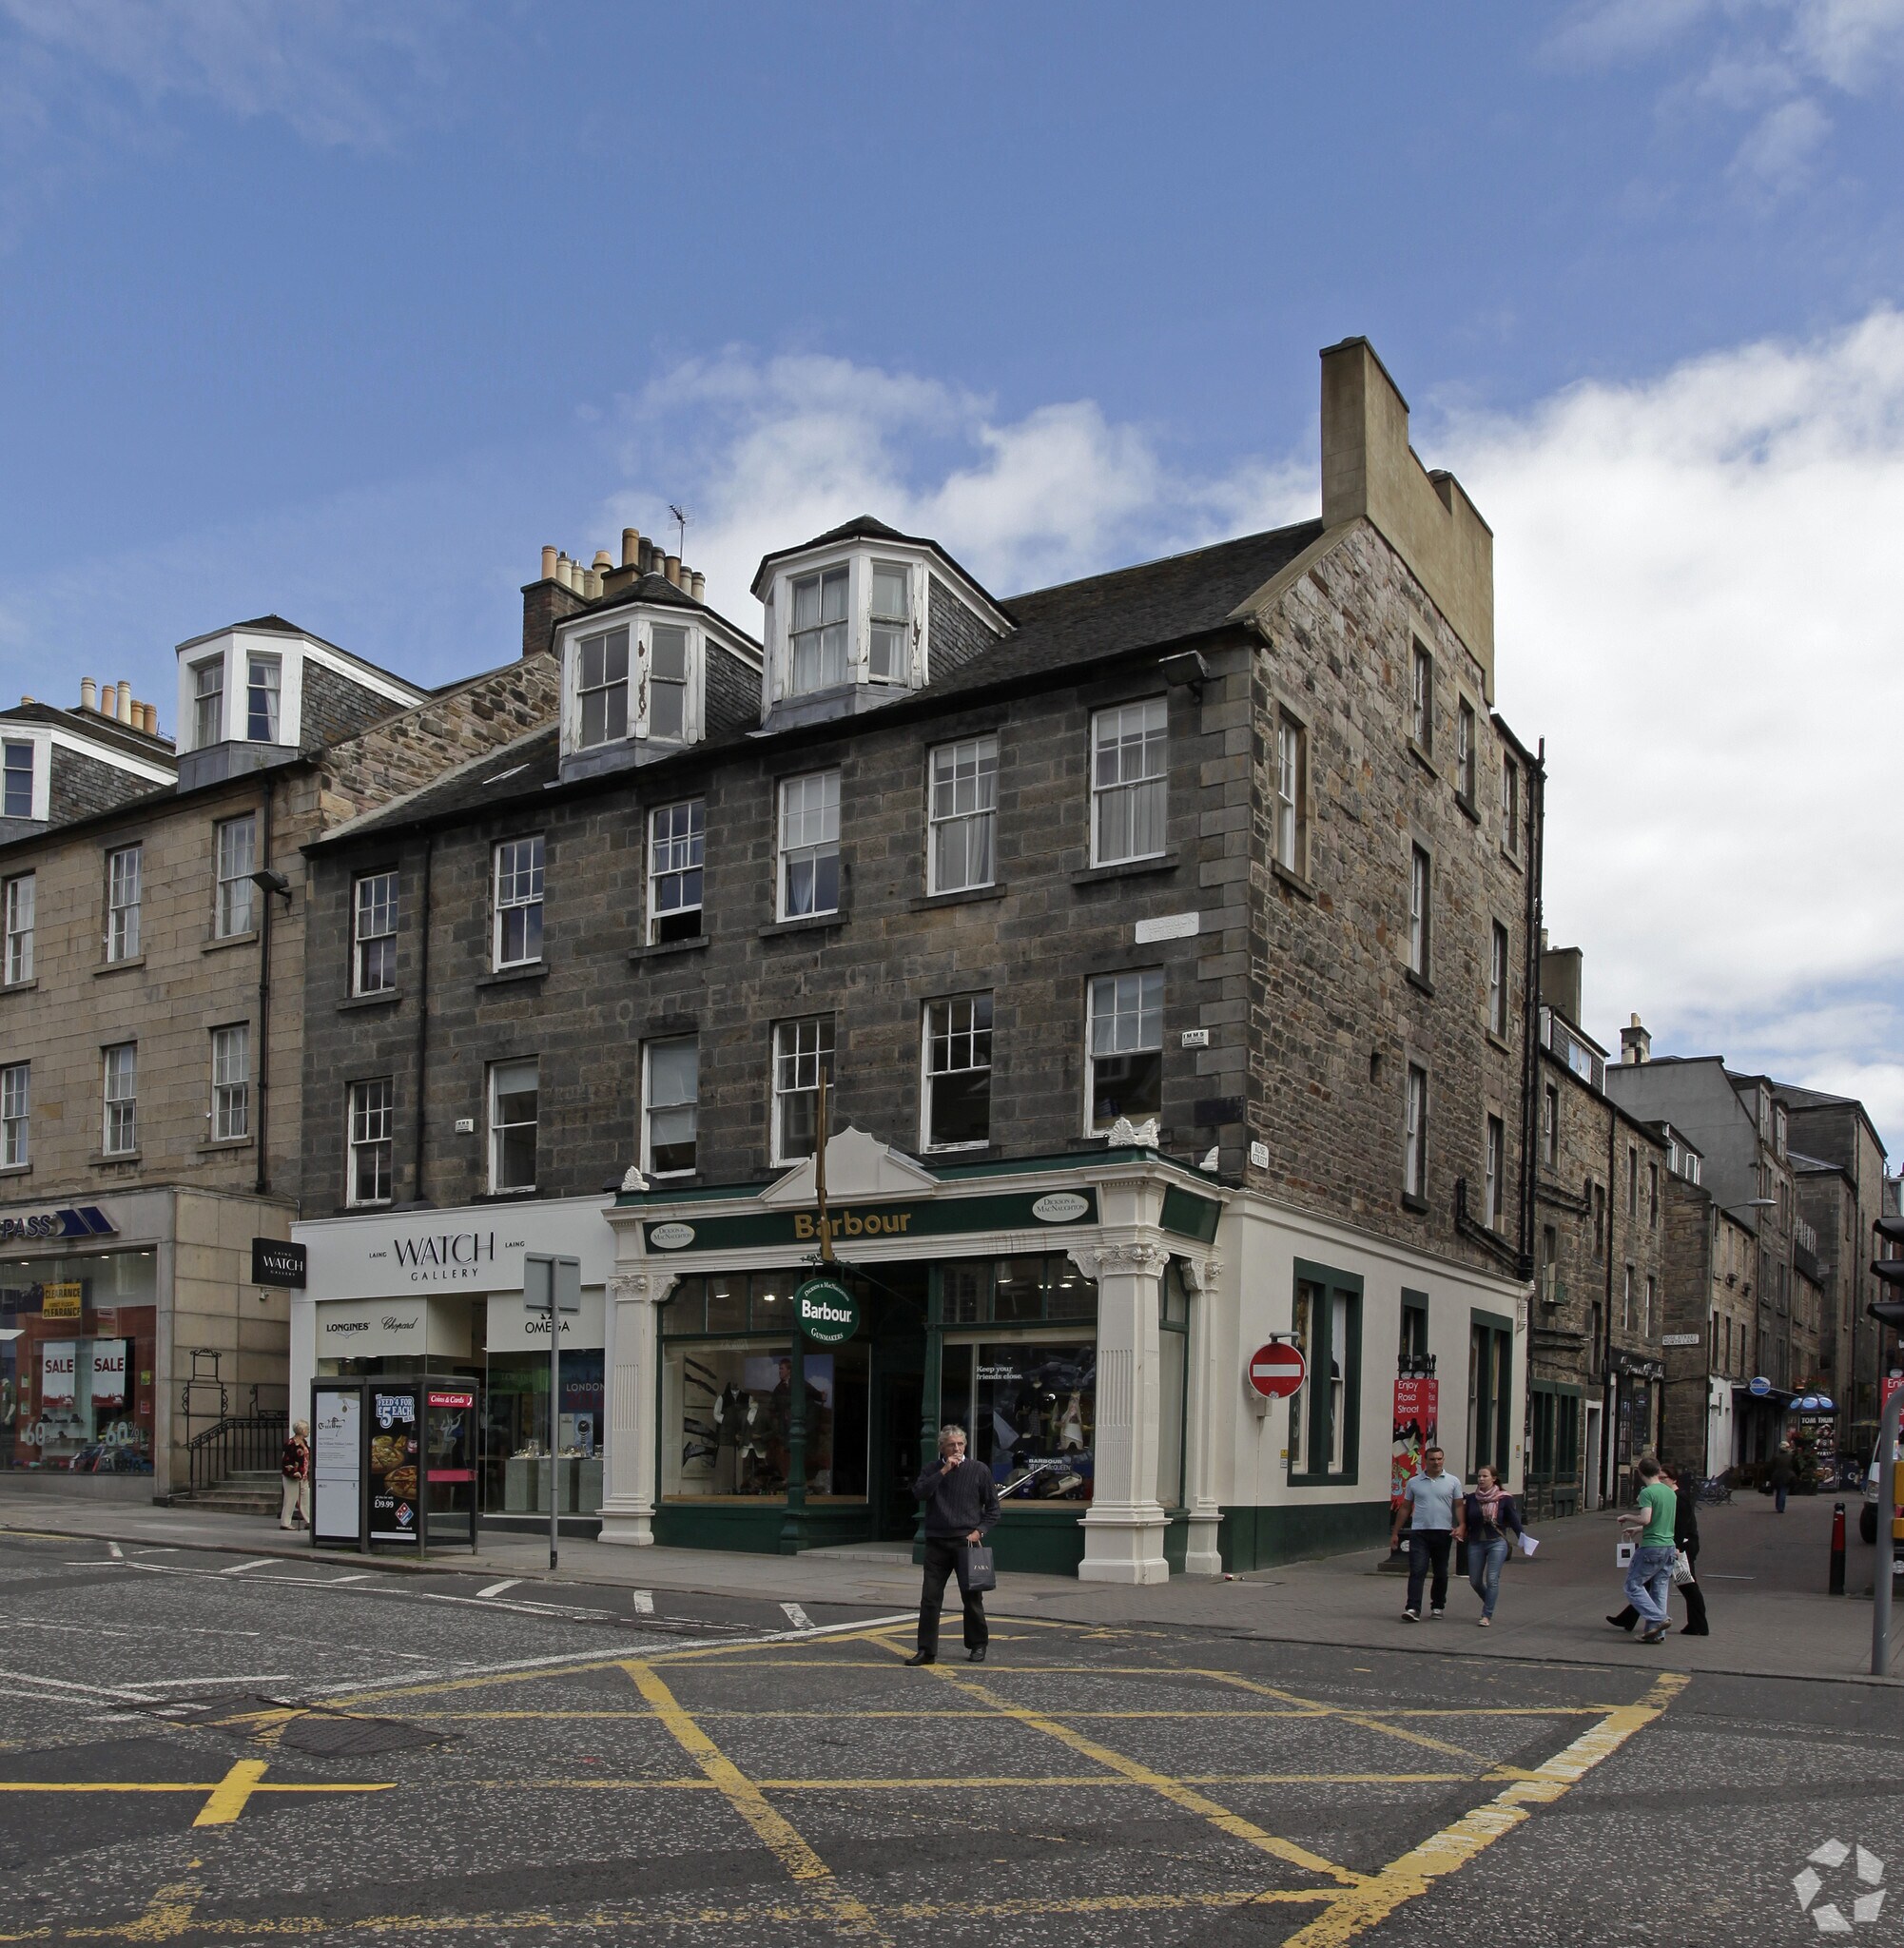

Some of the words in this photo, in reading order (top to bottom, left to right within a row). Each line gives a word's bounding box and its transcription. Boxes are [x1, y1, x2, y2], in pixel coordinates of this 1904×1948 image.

[1254, 1143, 1266, 1156] ROSE
[1252, 1153, 1267, 1166] STREET
[394, 1231, 495, 1267] WATCH
[263, 1256, 303, 1272] WATCH
[411, 1268, 478, 1281] GALLERY
[45, 1287, 81, 1299] CLEARANCE
[44, 1307, 81, 1317] CLEARANCE
[802, 1299, 852, 1322] Barbour
[326, 1323, 369, 1333] LONGINES
[381, 1316, 418, 1334] Chopard
[45, 1359, 74, 1373] SALE
[94, 1357, 124, 1372] SALE
[976, 1365, 995, 1373] Keep
[566, 1382, 605, 1392] LONDON
[1398, 1380, 1418, 1392] Enjoy
[379, 1398, 394, 1407] FEED
[395, 1398, 399, 1407] 4
[400, 1398, 413, 1407] FOR
[450, 1395, 464, 1404] Cards
[1398, 1393, 1417, 1401] Rose
[1397, 1405, 1419, 1413] Street
[379, 1406, 392, 1427] £5
[392, 1406, 413, 1415] EACH
[106, 1421, 140, 1447] 60%
[374, 1499, 394, 1509] £19.99
